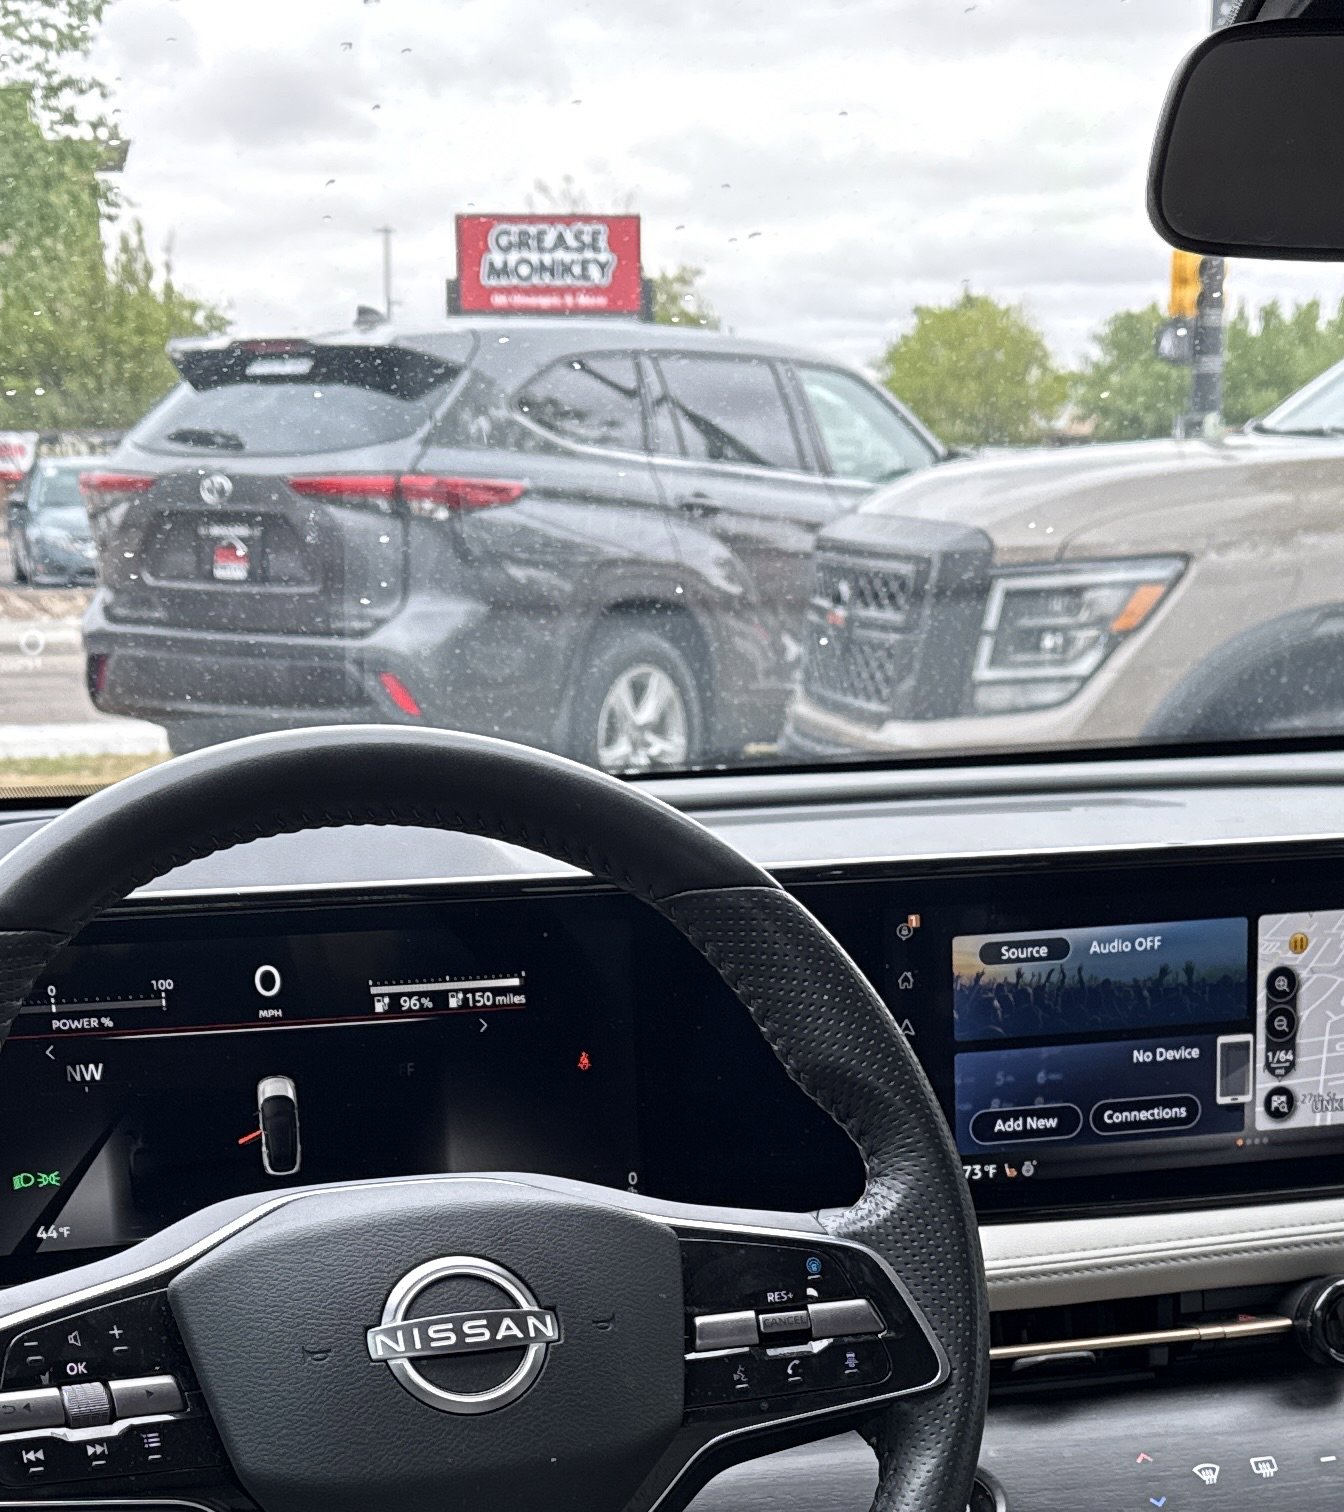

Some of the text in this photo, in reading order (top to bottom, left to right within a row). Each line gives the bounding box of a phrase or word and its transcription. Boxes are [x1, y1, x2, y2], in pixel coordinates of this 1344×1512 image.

[494, 228, 604, 253] GREASE
[485, 257, 612, 282] MONKEY
[1001, 944, 1048, 960] Source
[1089, 936, 1162, 955] Audio OFF
[151, 979, 174, 991] 100
[253, 964, 282, 997] 0
[47, 985, 57, 997] 0
[399, 995, 434, 1011] 96%
[466, 991, 527, 1008] 150 miles
[258, 1008, 283, 1019] MPH
[52, 1016, 114, 1031] POWER %
[1132, 1047, 1200, 1063] No Device
[1267, 1049, 1294, 1063] 1/64
[66, 1062, 104, 1082] NW
[1103, 1104, 1188, 1124] Connections
[994, 1114, 1058, 1133] Add New
[374, 1314, 555, 1356] NISSAN
[66, 1361, 88, 1376] OK
